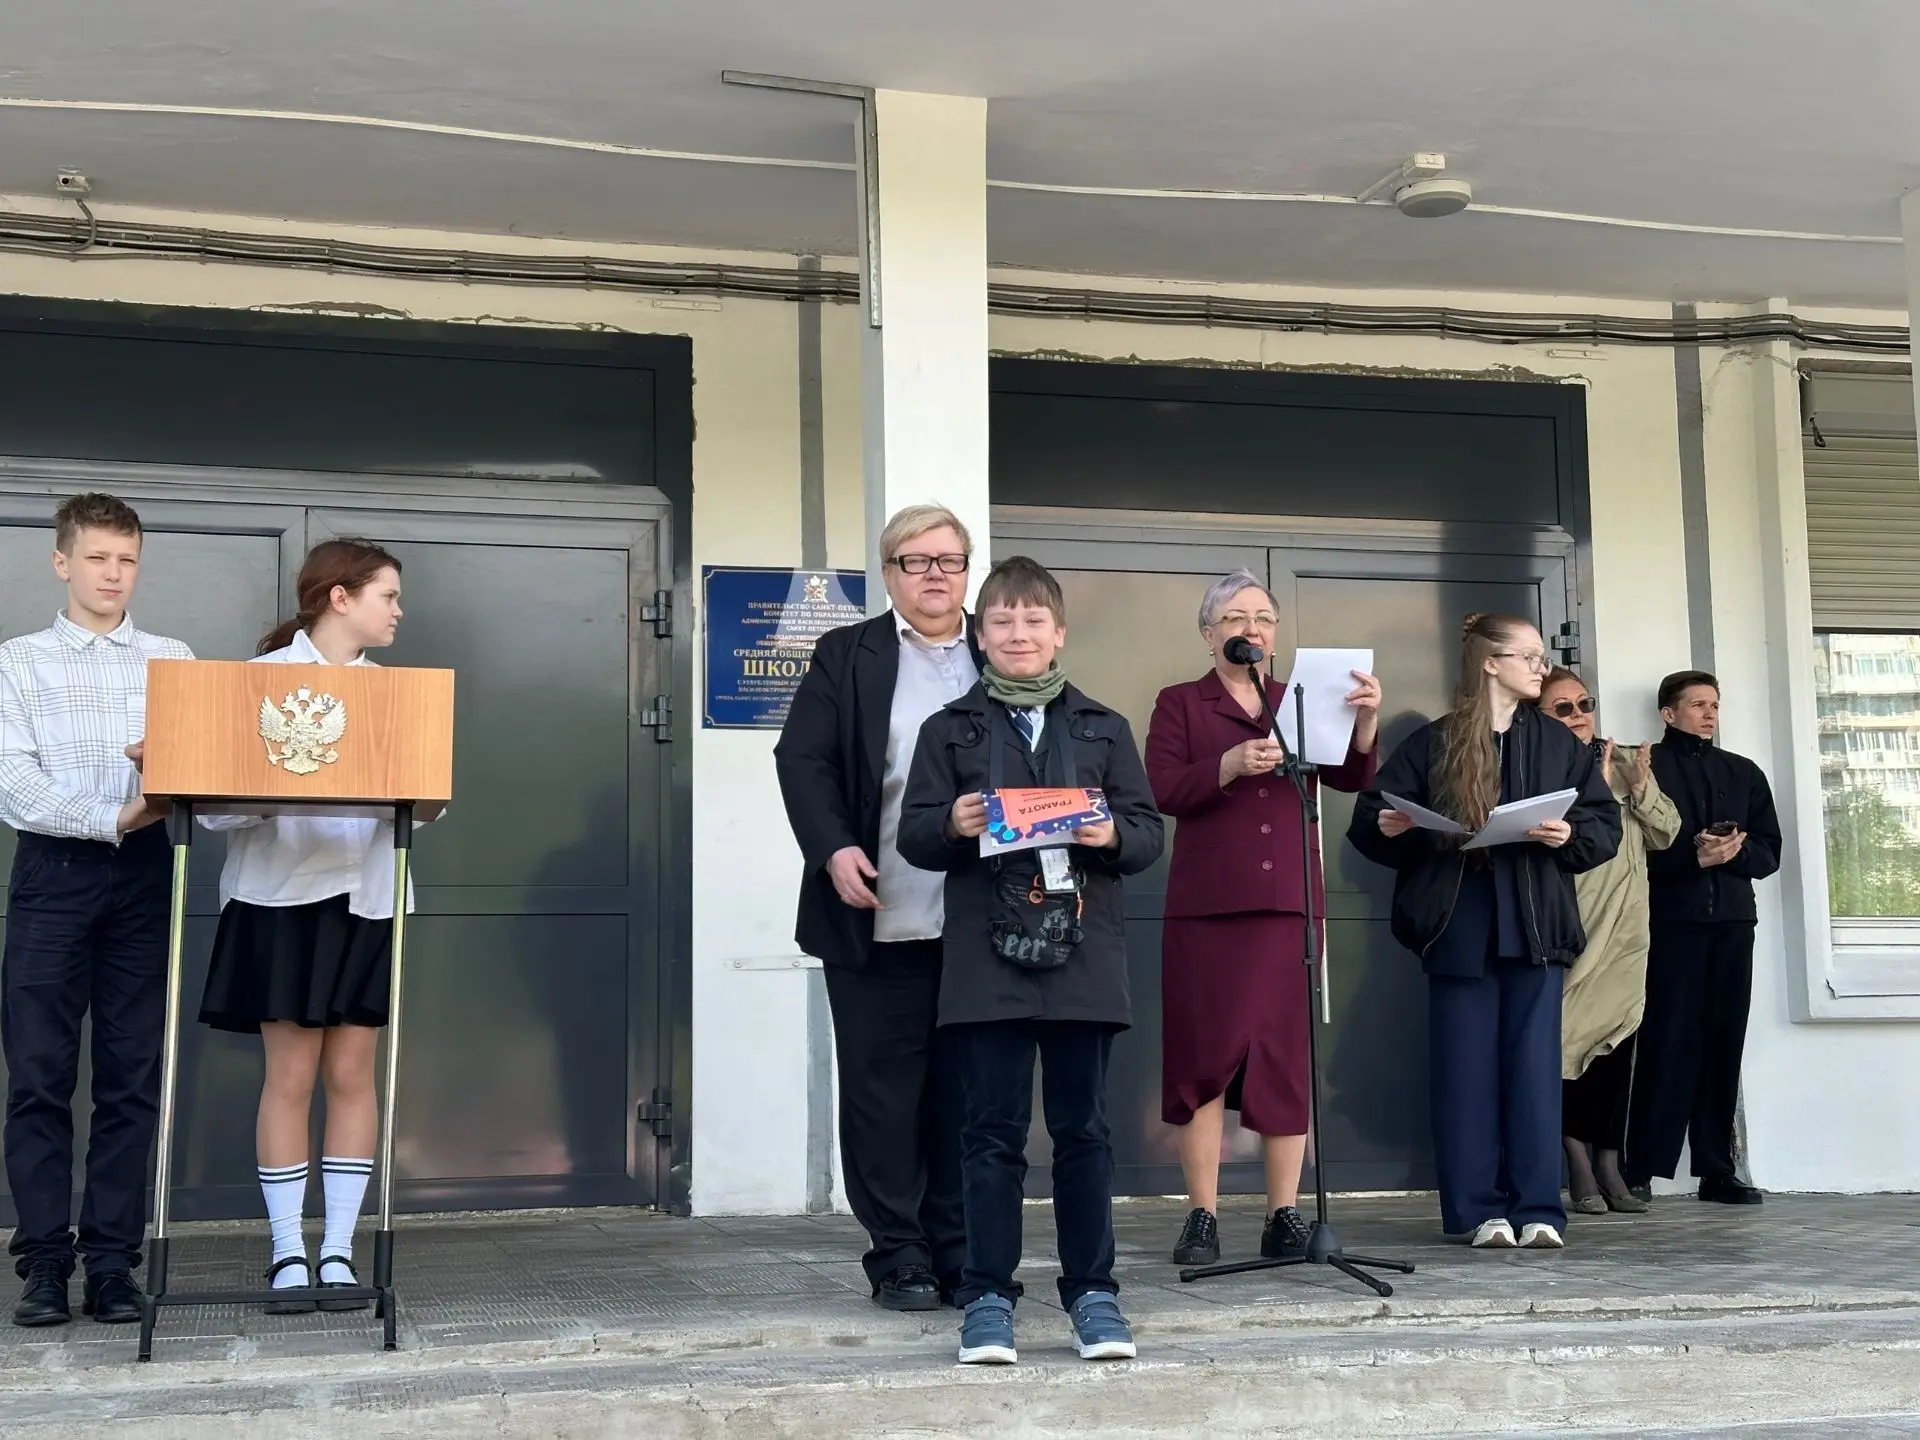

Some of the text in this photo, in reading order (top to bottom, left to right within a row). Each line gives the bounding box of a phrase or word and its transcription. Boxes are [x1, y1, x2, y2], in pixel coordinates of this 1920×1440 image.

[733, 648, 778, 658] СРЕДНЯЯ
[743, 659, 811, 677] ШКОЛ
[1018, 799, 1072, 815] ГРАМОТА
